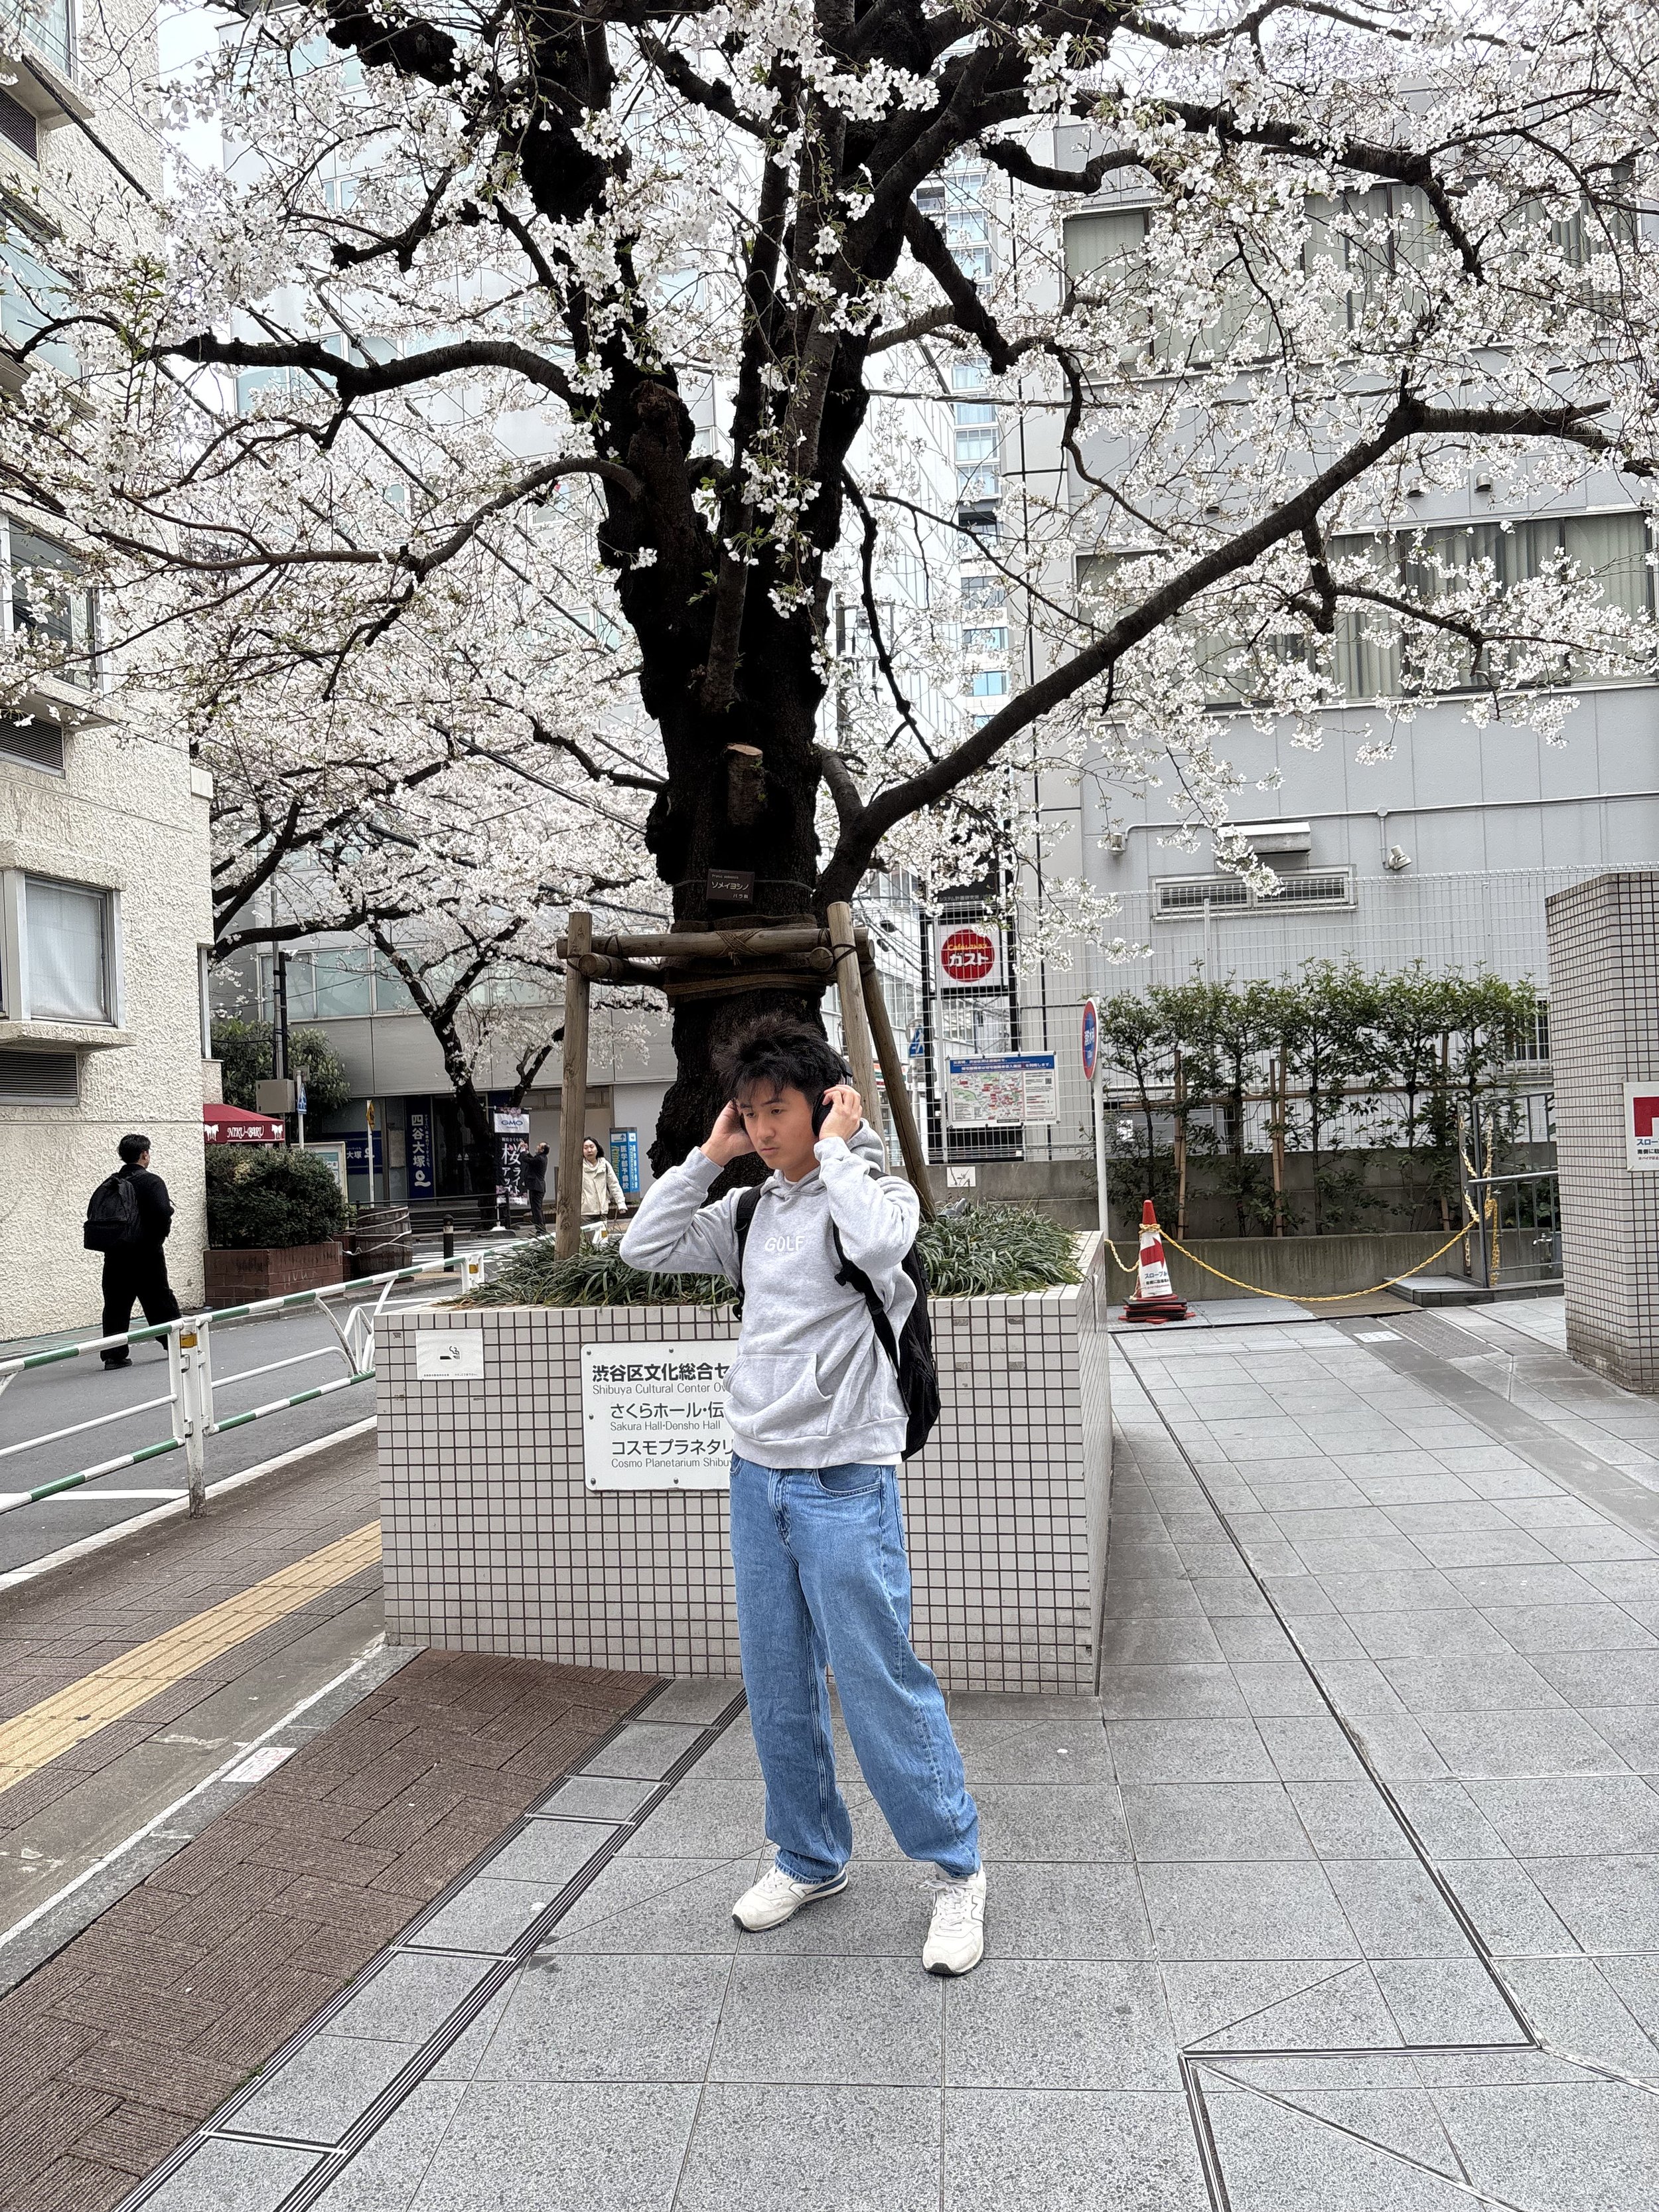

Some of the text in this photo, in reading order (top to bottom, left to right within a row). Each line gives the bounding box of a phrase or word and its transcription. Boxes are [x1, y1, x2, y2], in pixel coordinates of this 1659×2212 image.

[711, 881, 749, 891] ソメイヨシノ
[949, 952, 989, 967] ガスト
[226, 1125, 265, 1139] NIKU-BARU
[411, 1114, 425, 1167] 四谷大塚
[501, 1143, 522, 1165] 桜
[502, 1167, 513, 1193] アップ
[512, 1167, 522, 1195] ライト
[764, 1235, 805, 1252] GOLF
[592, 1362, 730, 1382] 渋谷区文化総合セ
[592, 1384, 632, 1395] Shibuya
[635, 1383, 674, 1394] Cultural
[677, 1382, 710, 1393] Center
[610, 1401, 725, 1419] さくらホール・伝
[610, 1422, 642, 1432] Sakura
[703, 1420, 721, 1430] Hall
[612, 1438, 733, 1455] コスモプラネタリ
[611, 1459, 643, 1468] Cosmo
[645, 1458, 700, 1468] Planetarium
